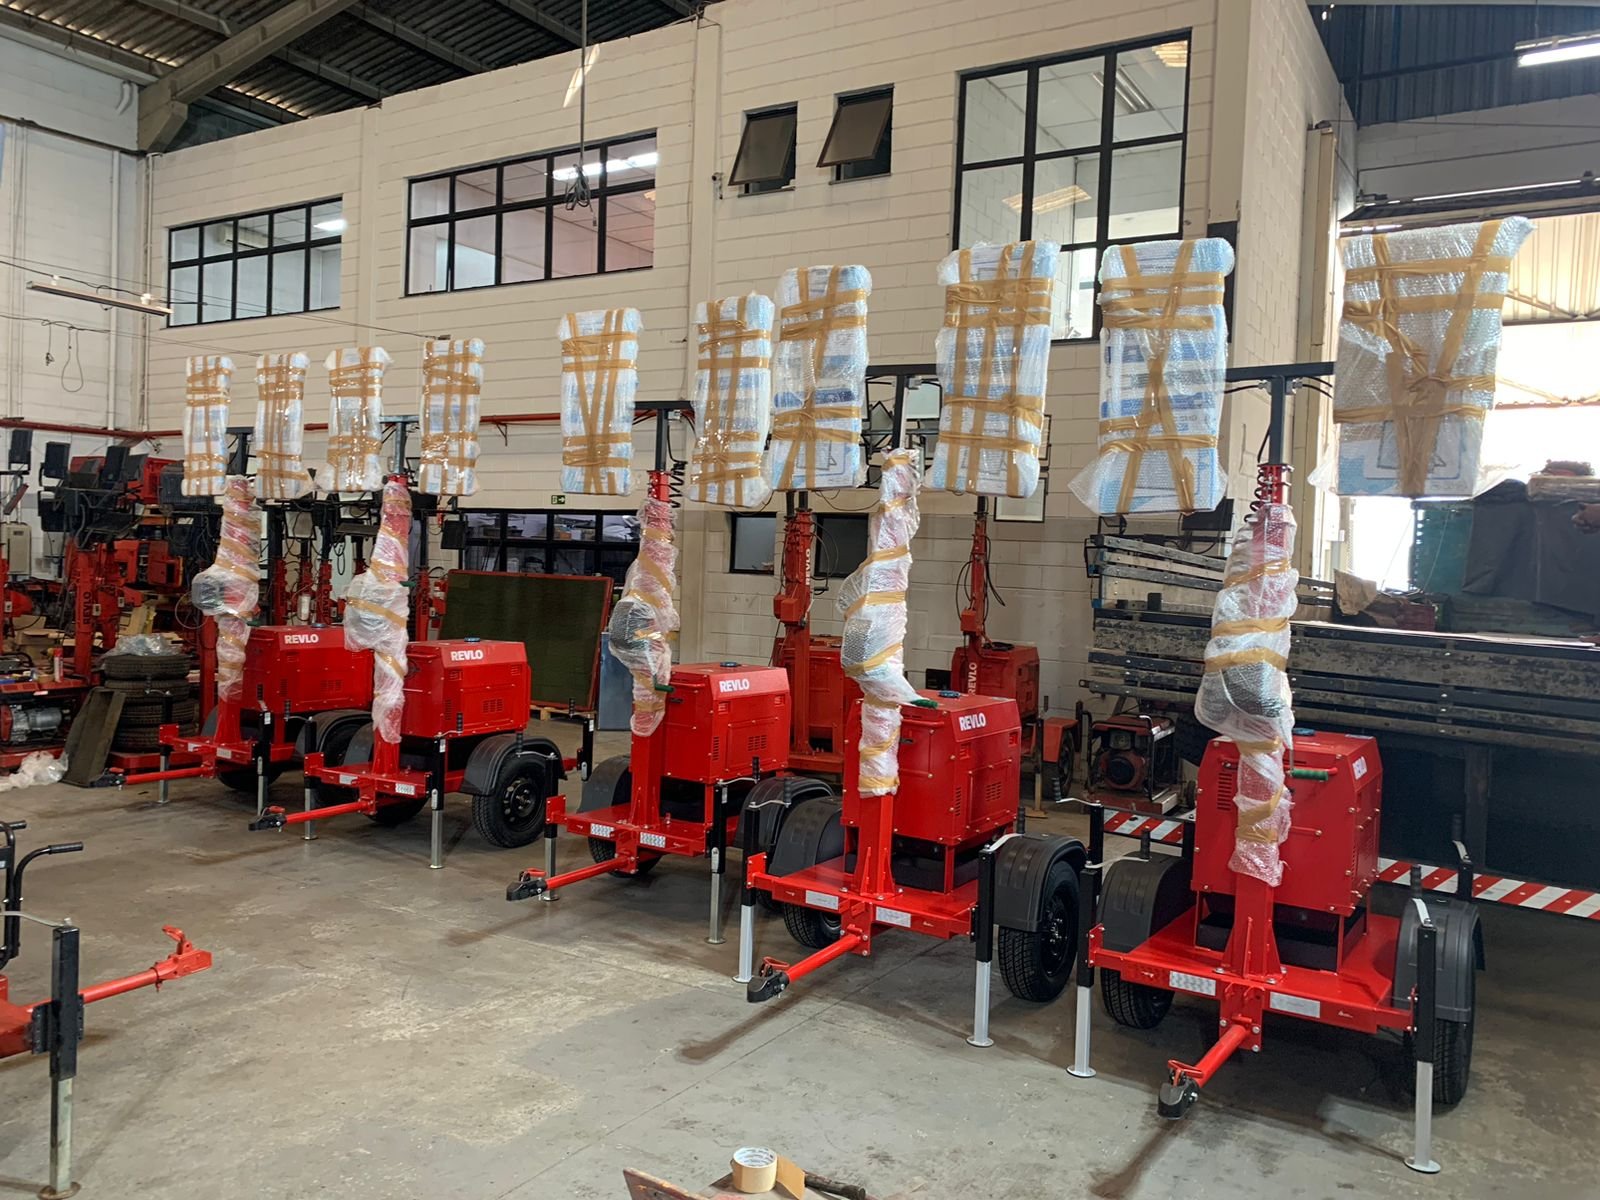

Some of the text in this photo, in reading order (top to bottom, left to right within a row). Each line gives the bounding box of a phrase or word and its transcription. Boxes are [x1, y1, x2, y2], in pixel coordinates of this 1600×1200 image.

[284, 634, 319, 644] REVLO
[451, 650, 484, 661] REVLO
[968, 662, 977, 695] REVLO
[719, 679, 750, 692] REVLO
[958, 713, 986, 731] REVLO
